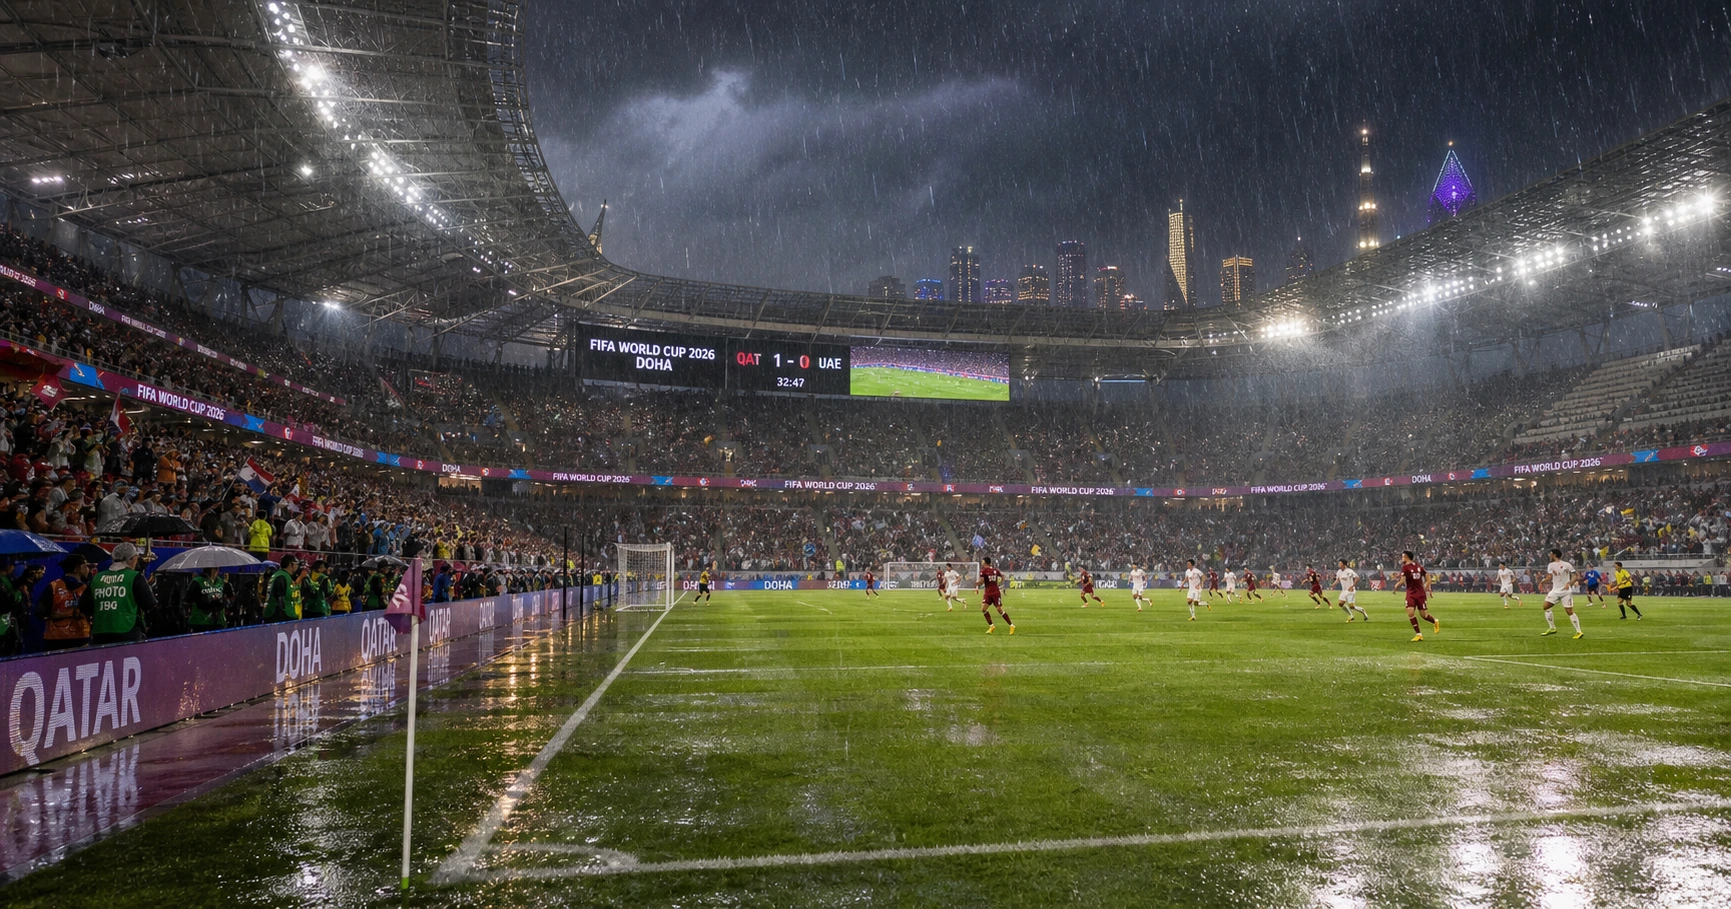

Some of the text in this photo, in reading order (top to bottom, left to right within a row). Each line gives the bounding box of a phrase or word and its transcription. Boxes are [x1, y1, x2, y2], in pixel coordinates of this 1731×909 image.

[590, 338, 715, 360] FIFA WORLD CUP 2026
[635, 356, 673, 372] DOHA
[736, 351, 762, 366] QAT
[773, 353, 781, 367] 1
[799, 354, 810, 369] 0
[818, 357, 842, 370] UAE
[776, 376, 805, 388] 32:47
[137, 383, 157, 403] FIFA
[158, 390, 189, 410] WORLD
[189, 400, 206, 415] CUP
[1514, 457, 1601, 474] FIFA WORLD CUP 2026
[552, 472, 569, 481] FIFA
[569, 473, 596, 482] WORLD
[596, 475, 612, 483] CUP
[784, 480, 803, 489] FIFA
[804, 481, 835, 490] WORLD
[835, 481, 854, 490] CUP
[1031, 484, 1048, 494] FIFA
[1048, 485, 1078, 495] WORLD
[1078, 486, 1095, 495] CUP
[1250, 486, 1266, 494] FIFA
[1266, 484, 1293, 493] WORLD
[94, 586, 127, 600] PHOTO
[764, 580, 793, 590] DOHA
[429, 607, 451, 646] QATAR
[361, 617, 397, 664] QATAR
[276, 626, 322, 684] DOHA
[8, 656, 142, 766] QATAR
